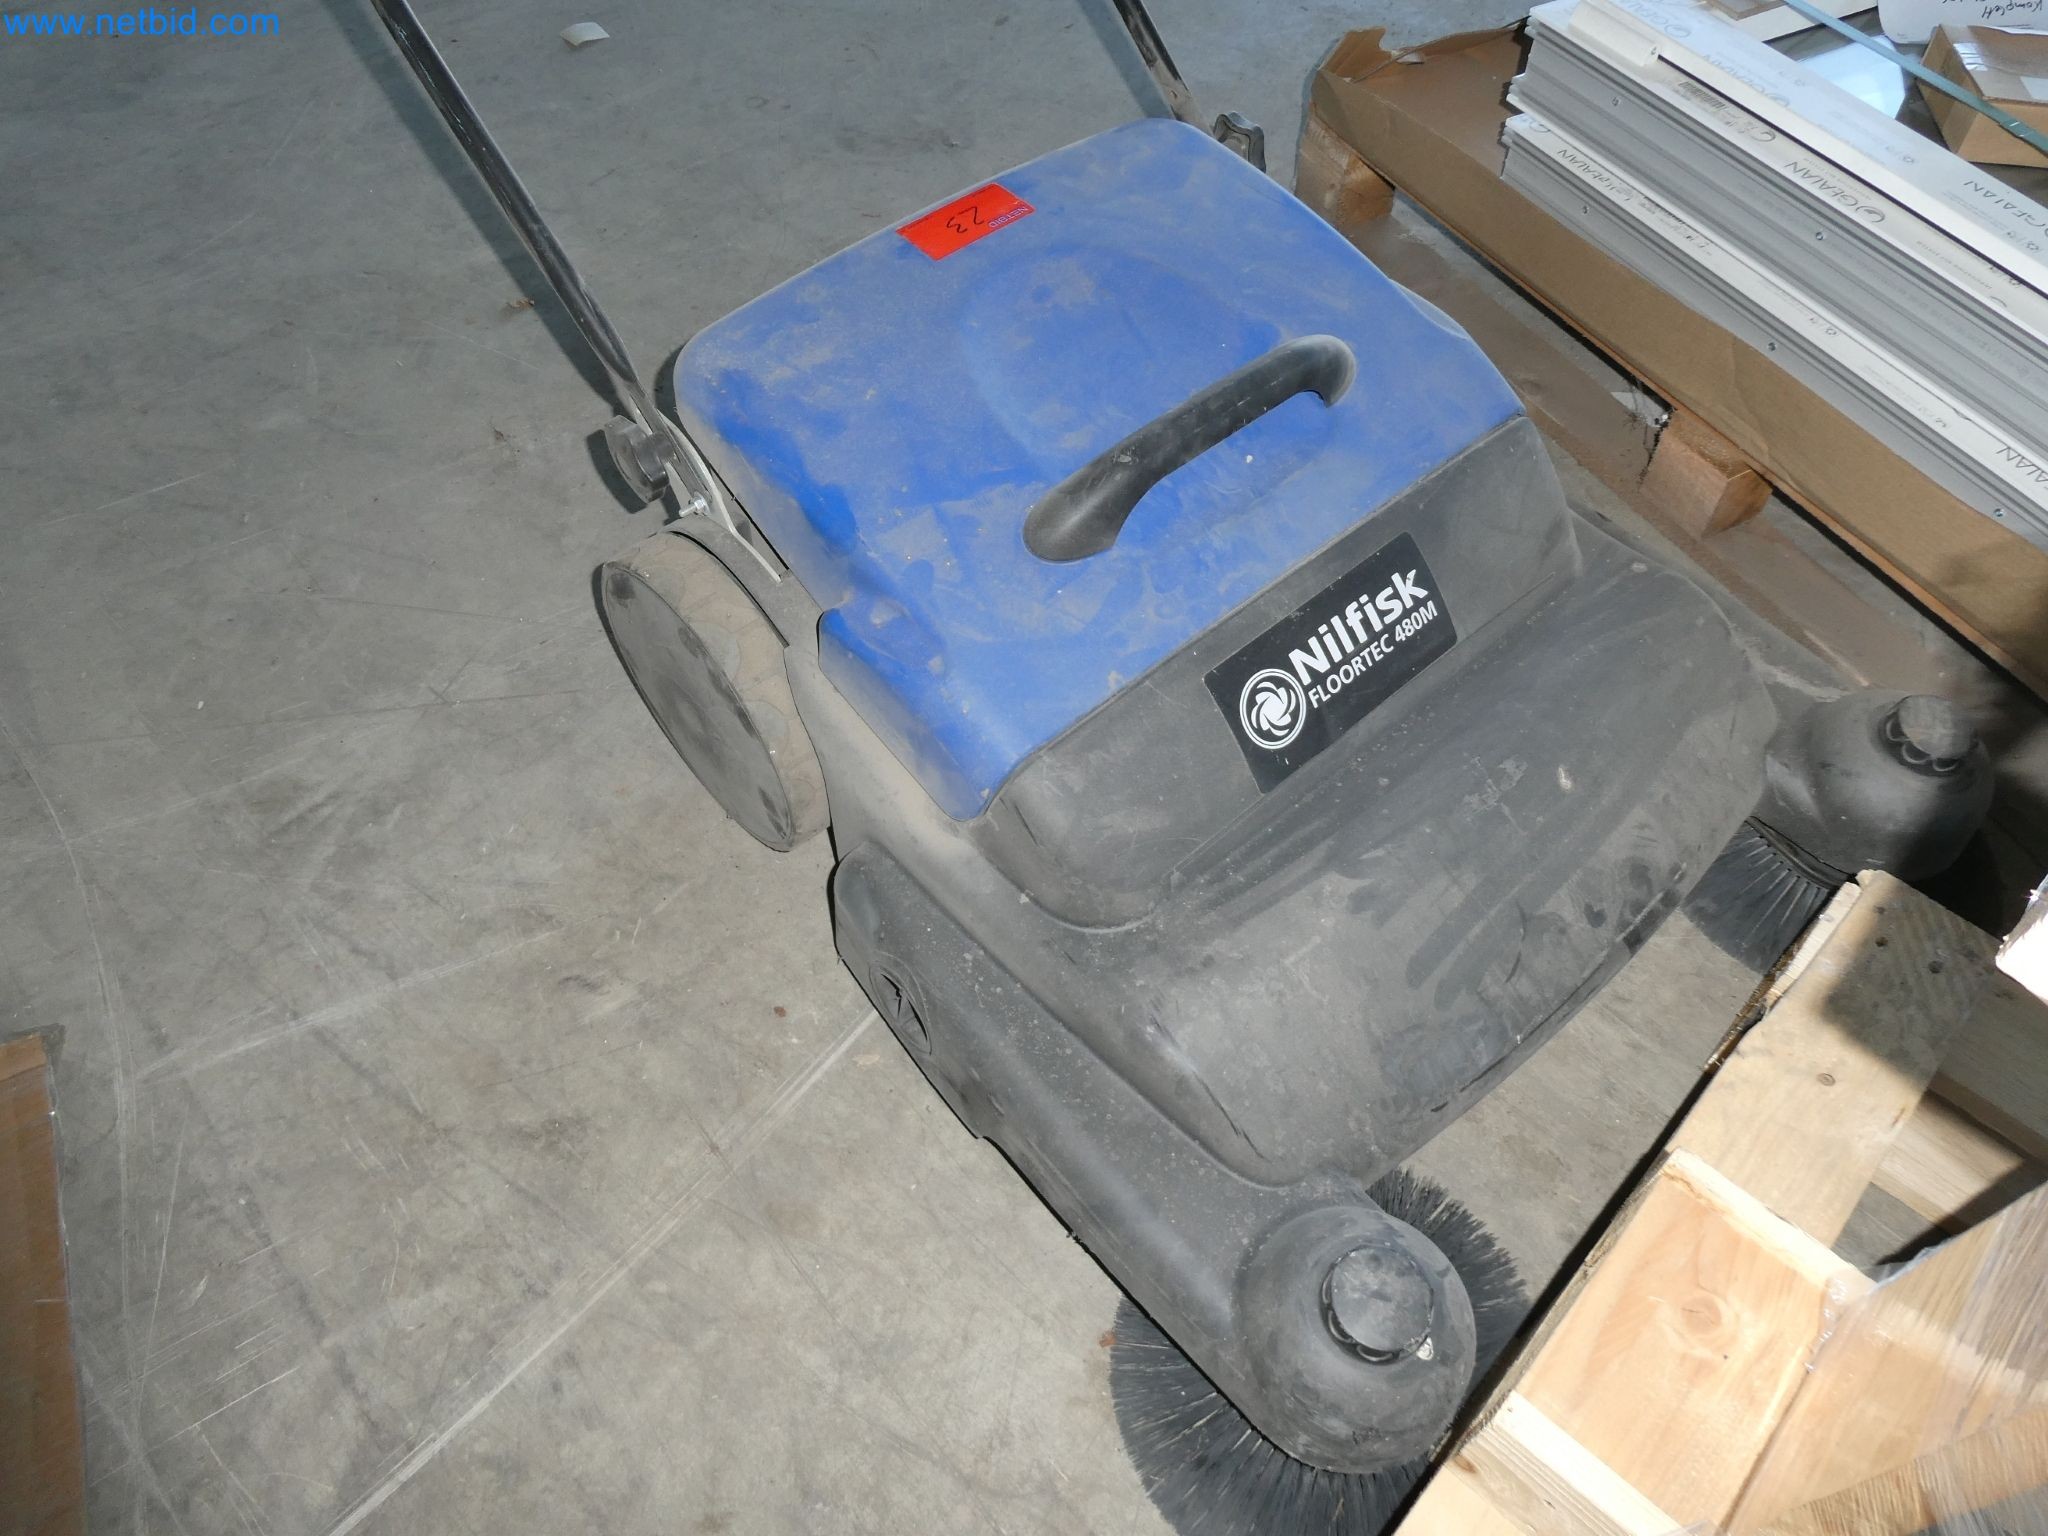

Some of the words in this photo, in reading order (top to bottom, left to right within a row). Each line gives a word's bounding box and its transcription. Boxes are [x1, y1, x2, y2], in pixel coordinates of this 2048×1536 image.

[946, 206, 985, 234] 23
[1289, 569, 1429, 686] Nilfisk
[1307, 633, 1395, 709] FLOORTEC
[1394, 600, 1438, 644] 480M
